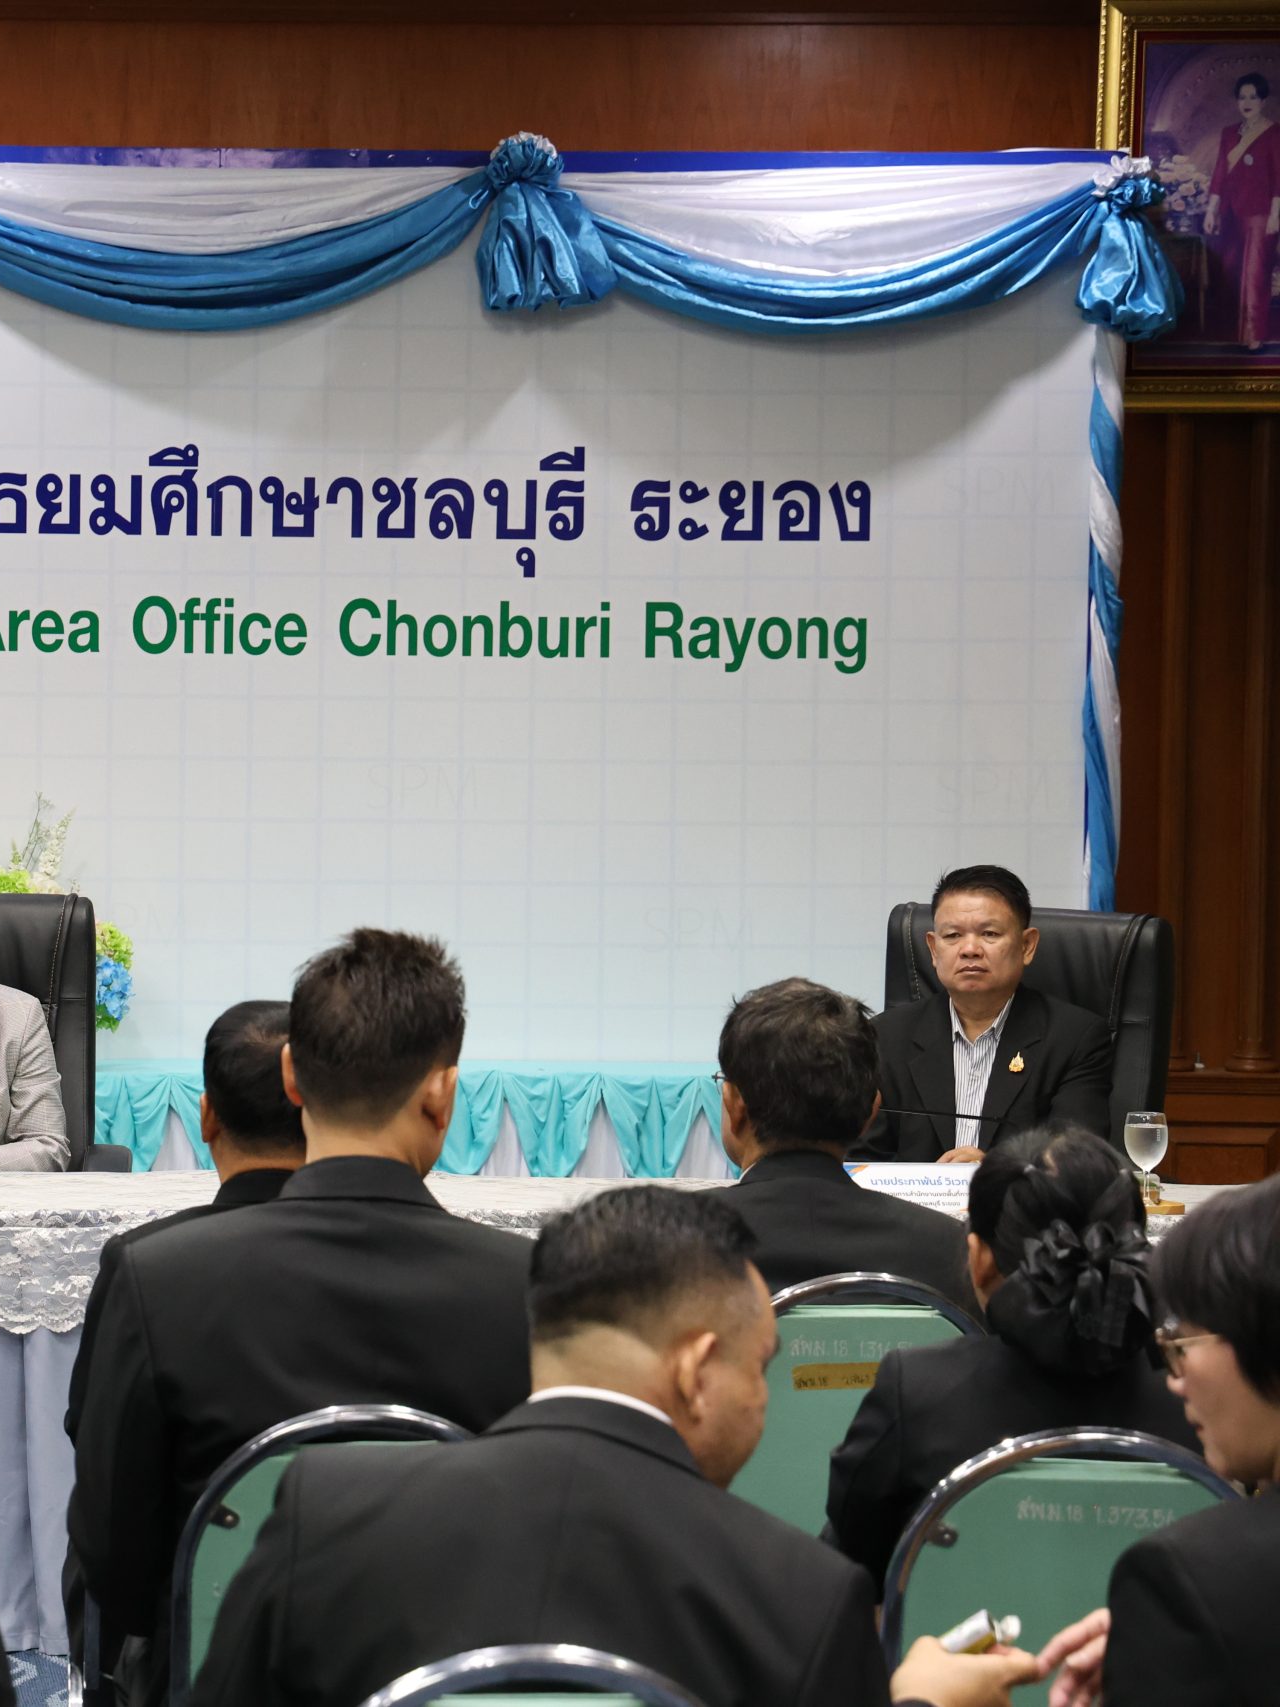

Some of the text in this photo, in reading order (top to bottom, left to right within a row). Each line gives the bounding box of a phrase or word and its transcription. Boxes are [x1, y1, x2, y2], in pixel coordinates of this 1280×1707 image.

[630, 480, 871, 542] ระยอง
[131, 595, 308, 656] Office
[338, 598, 611, 659] Chonburi
[644, 602, 868, 674] Rayong
